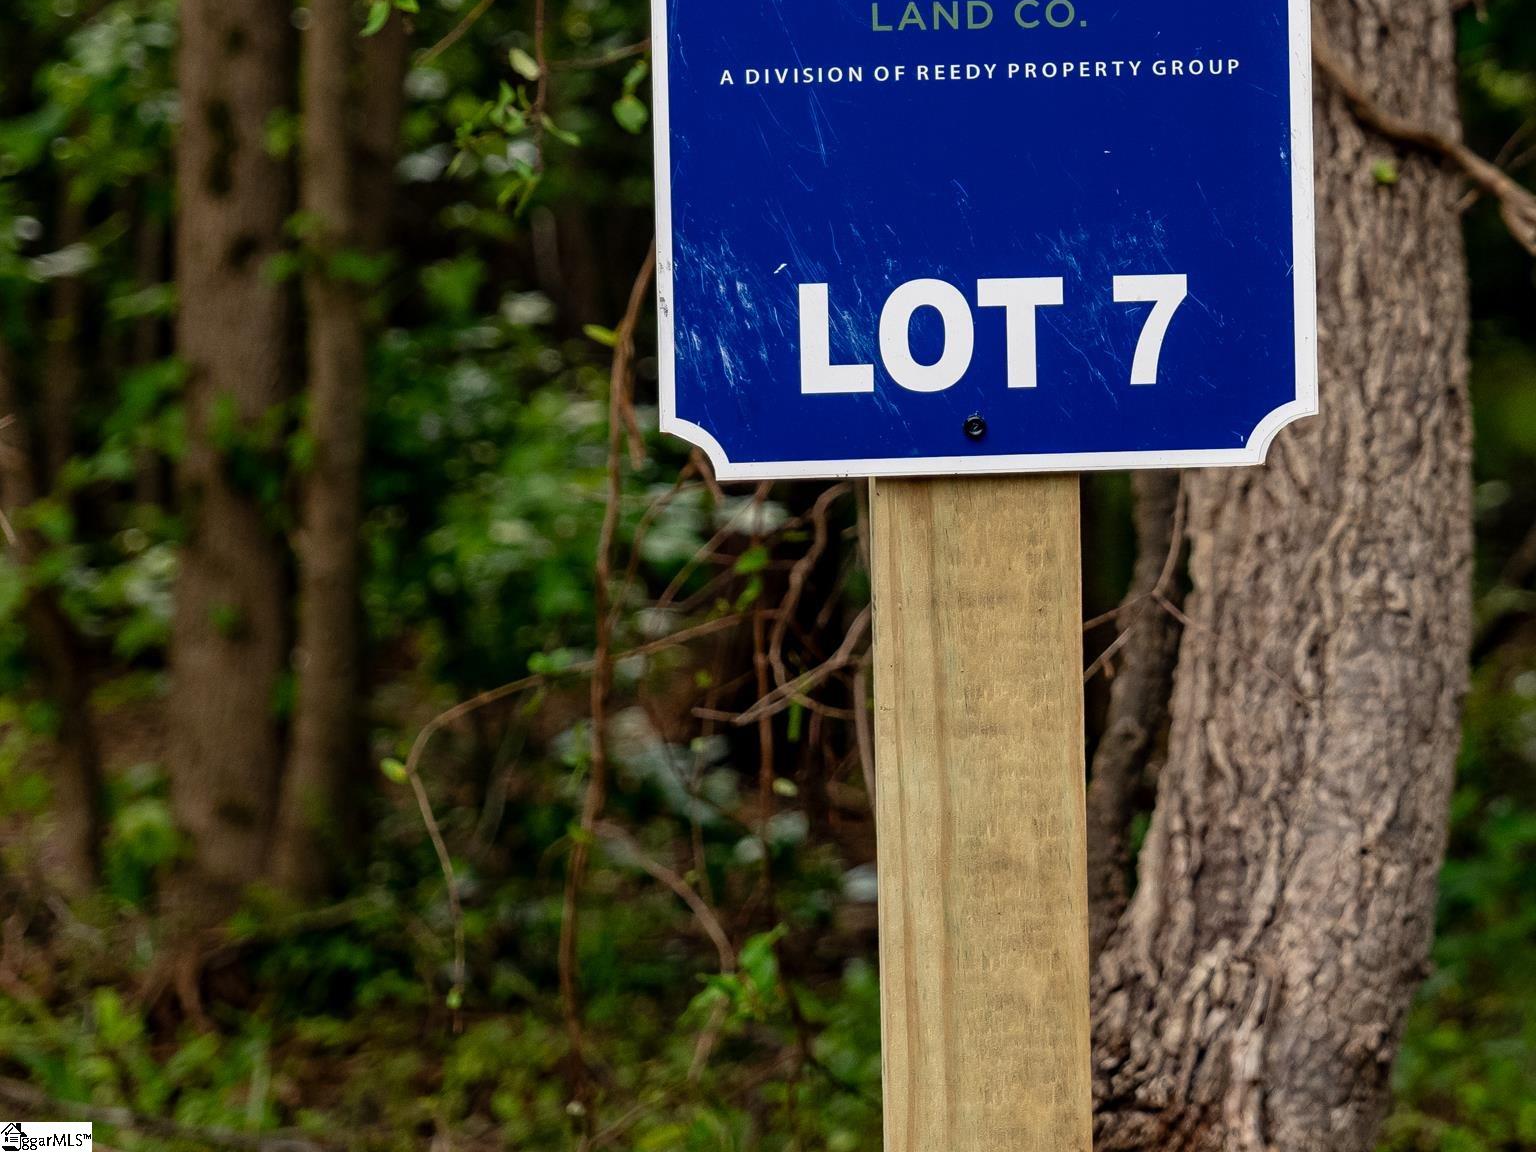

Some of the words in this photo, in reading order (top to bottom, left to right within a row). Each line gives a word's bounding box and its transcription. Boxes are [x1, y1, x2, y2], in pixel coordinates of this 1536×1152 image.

[871, 0, 994, 32] LAND
[720, 70, 734, 85] A
[745, 67, 863, 85] DIVISION
[874, 65, 906, 81] OF
[916, 63, 997, 80] REEDY
[1008, 61, 1142, 79] PROPERTY
[1152, 58, 1240, 76] GROUP
[798, 276, 1064, 395] LOT
[1112, 273, 1188, 385] 7
